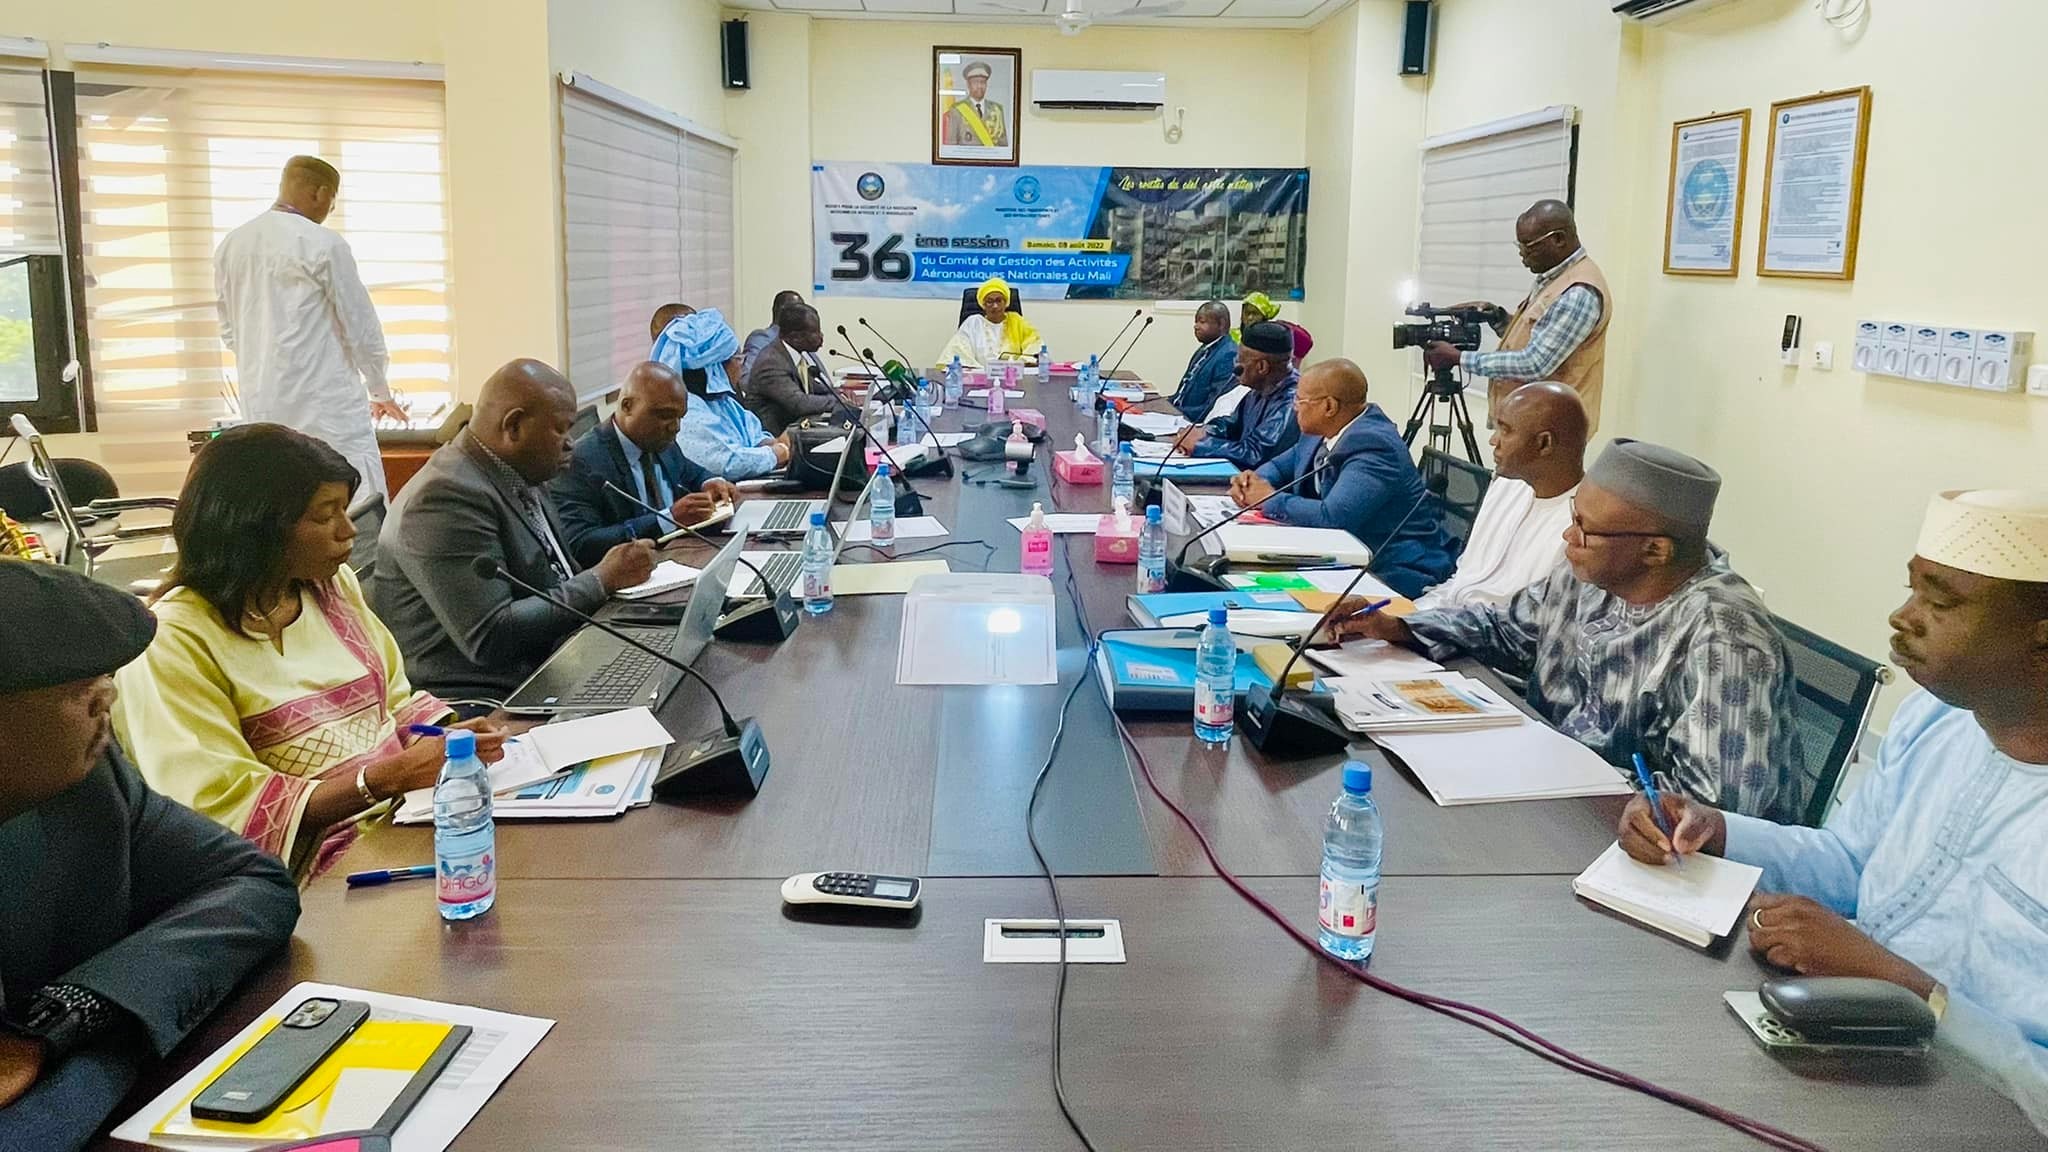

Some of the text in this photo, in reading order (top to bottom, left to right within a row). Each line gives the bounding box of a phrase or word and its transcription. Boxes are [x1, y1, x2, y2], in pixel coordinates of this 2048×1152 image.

[915, 233, 1010, 249] ème session
[1087, 242, 1105, 250] 2022
[830, 232, 913, 282] 36
[921, 255, 1118, 268] du Comité de Gestion des Activités
[921, 268, 1112, 281] Aéronautiques Nationales du Mali
[440, 871, 489, 890] DIAGO
